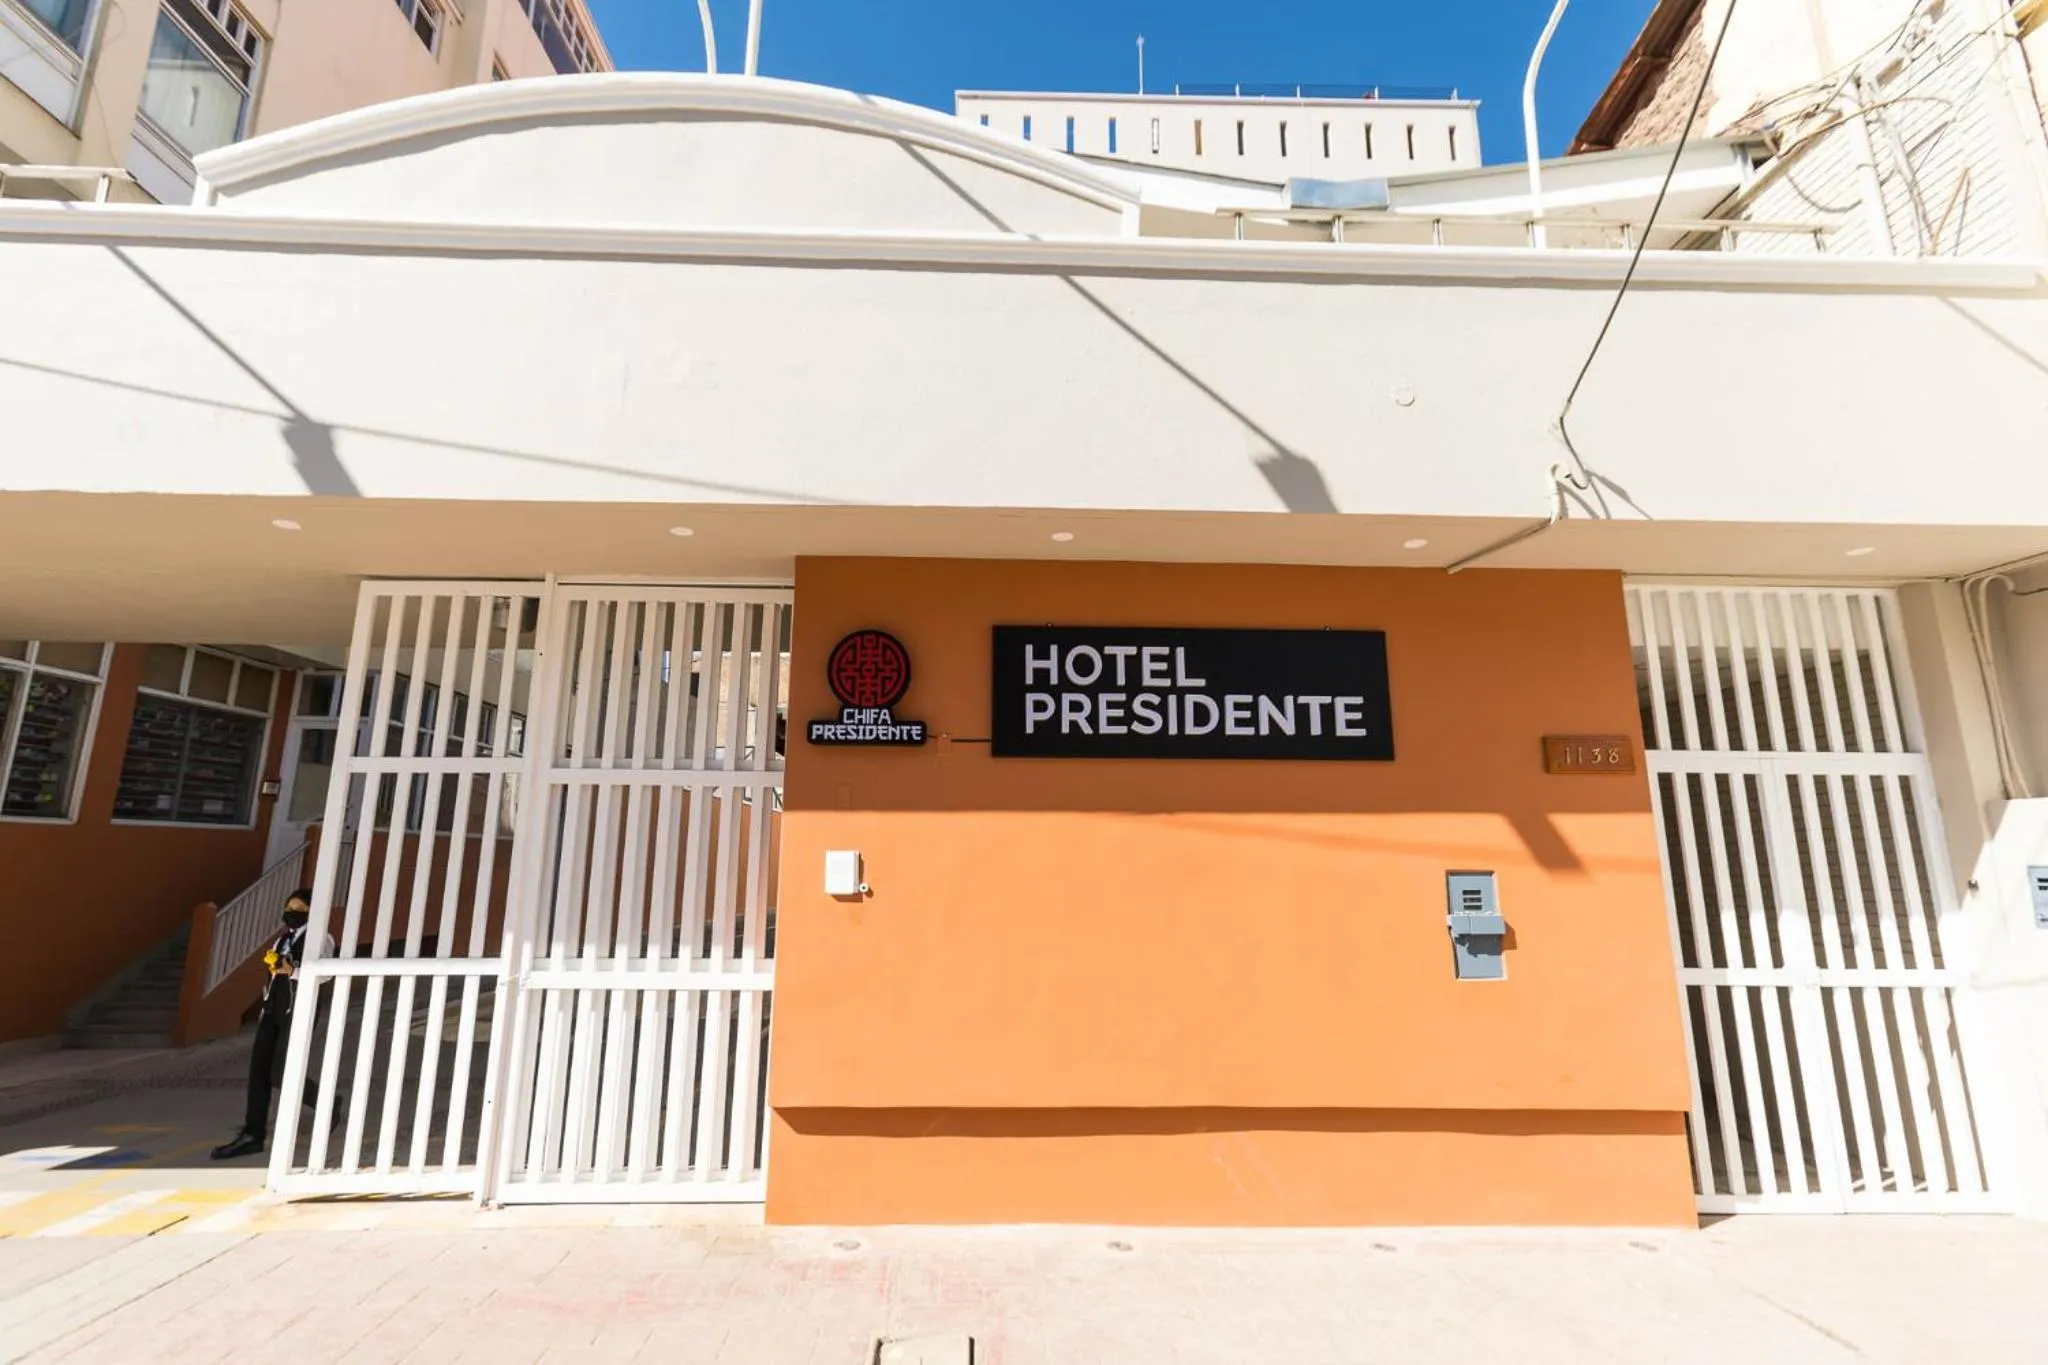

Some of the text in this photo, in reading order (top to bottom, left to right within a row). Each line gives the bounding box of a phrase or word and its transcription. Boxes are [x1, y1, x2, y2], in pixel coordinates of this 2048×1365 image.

[1025, 644, 1206, 687] HOTEL
[843, 708, 891, 724] CHIFA
[1025, 692, 1367, 737] PRESIDENTE
[812, 724, 922, 741] PRESIDENTE
[1564, 747, 1620, 765] 1138
